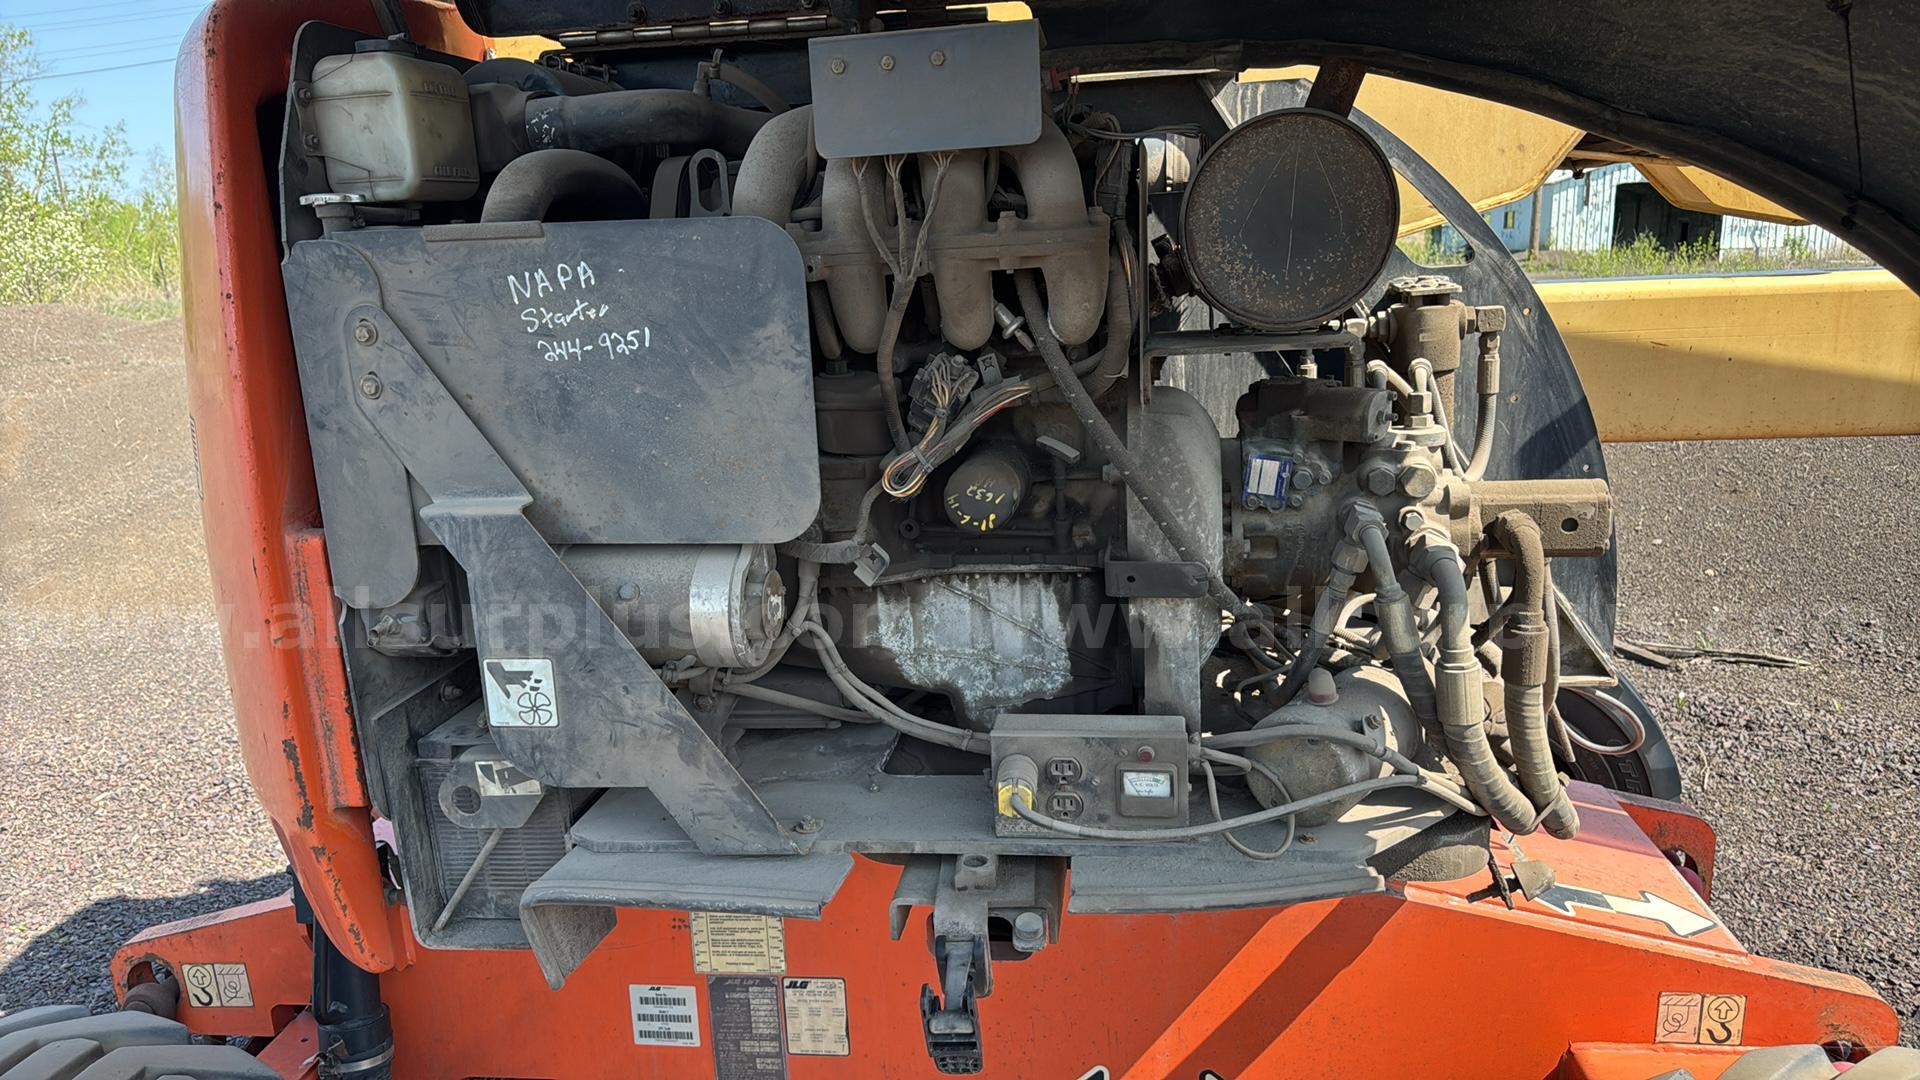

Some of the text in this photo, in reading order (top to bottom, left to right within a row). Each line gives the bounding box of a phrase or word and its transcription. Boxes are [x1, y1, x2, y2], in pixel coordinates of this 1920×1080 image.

[507, 261, 595, 304] NAPA
[537, 327, 650, 362] 244-9251
[785, 980, 809, 989] JLG
